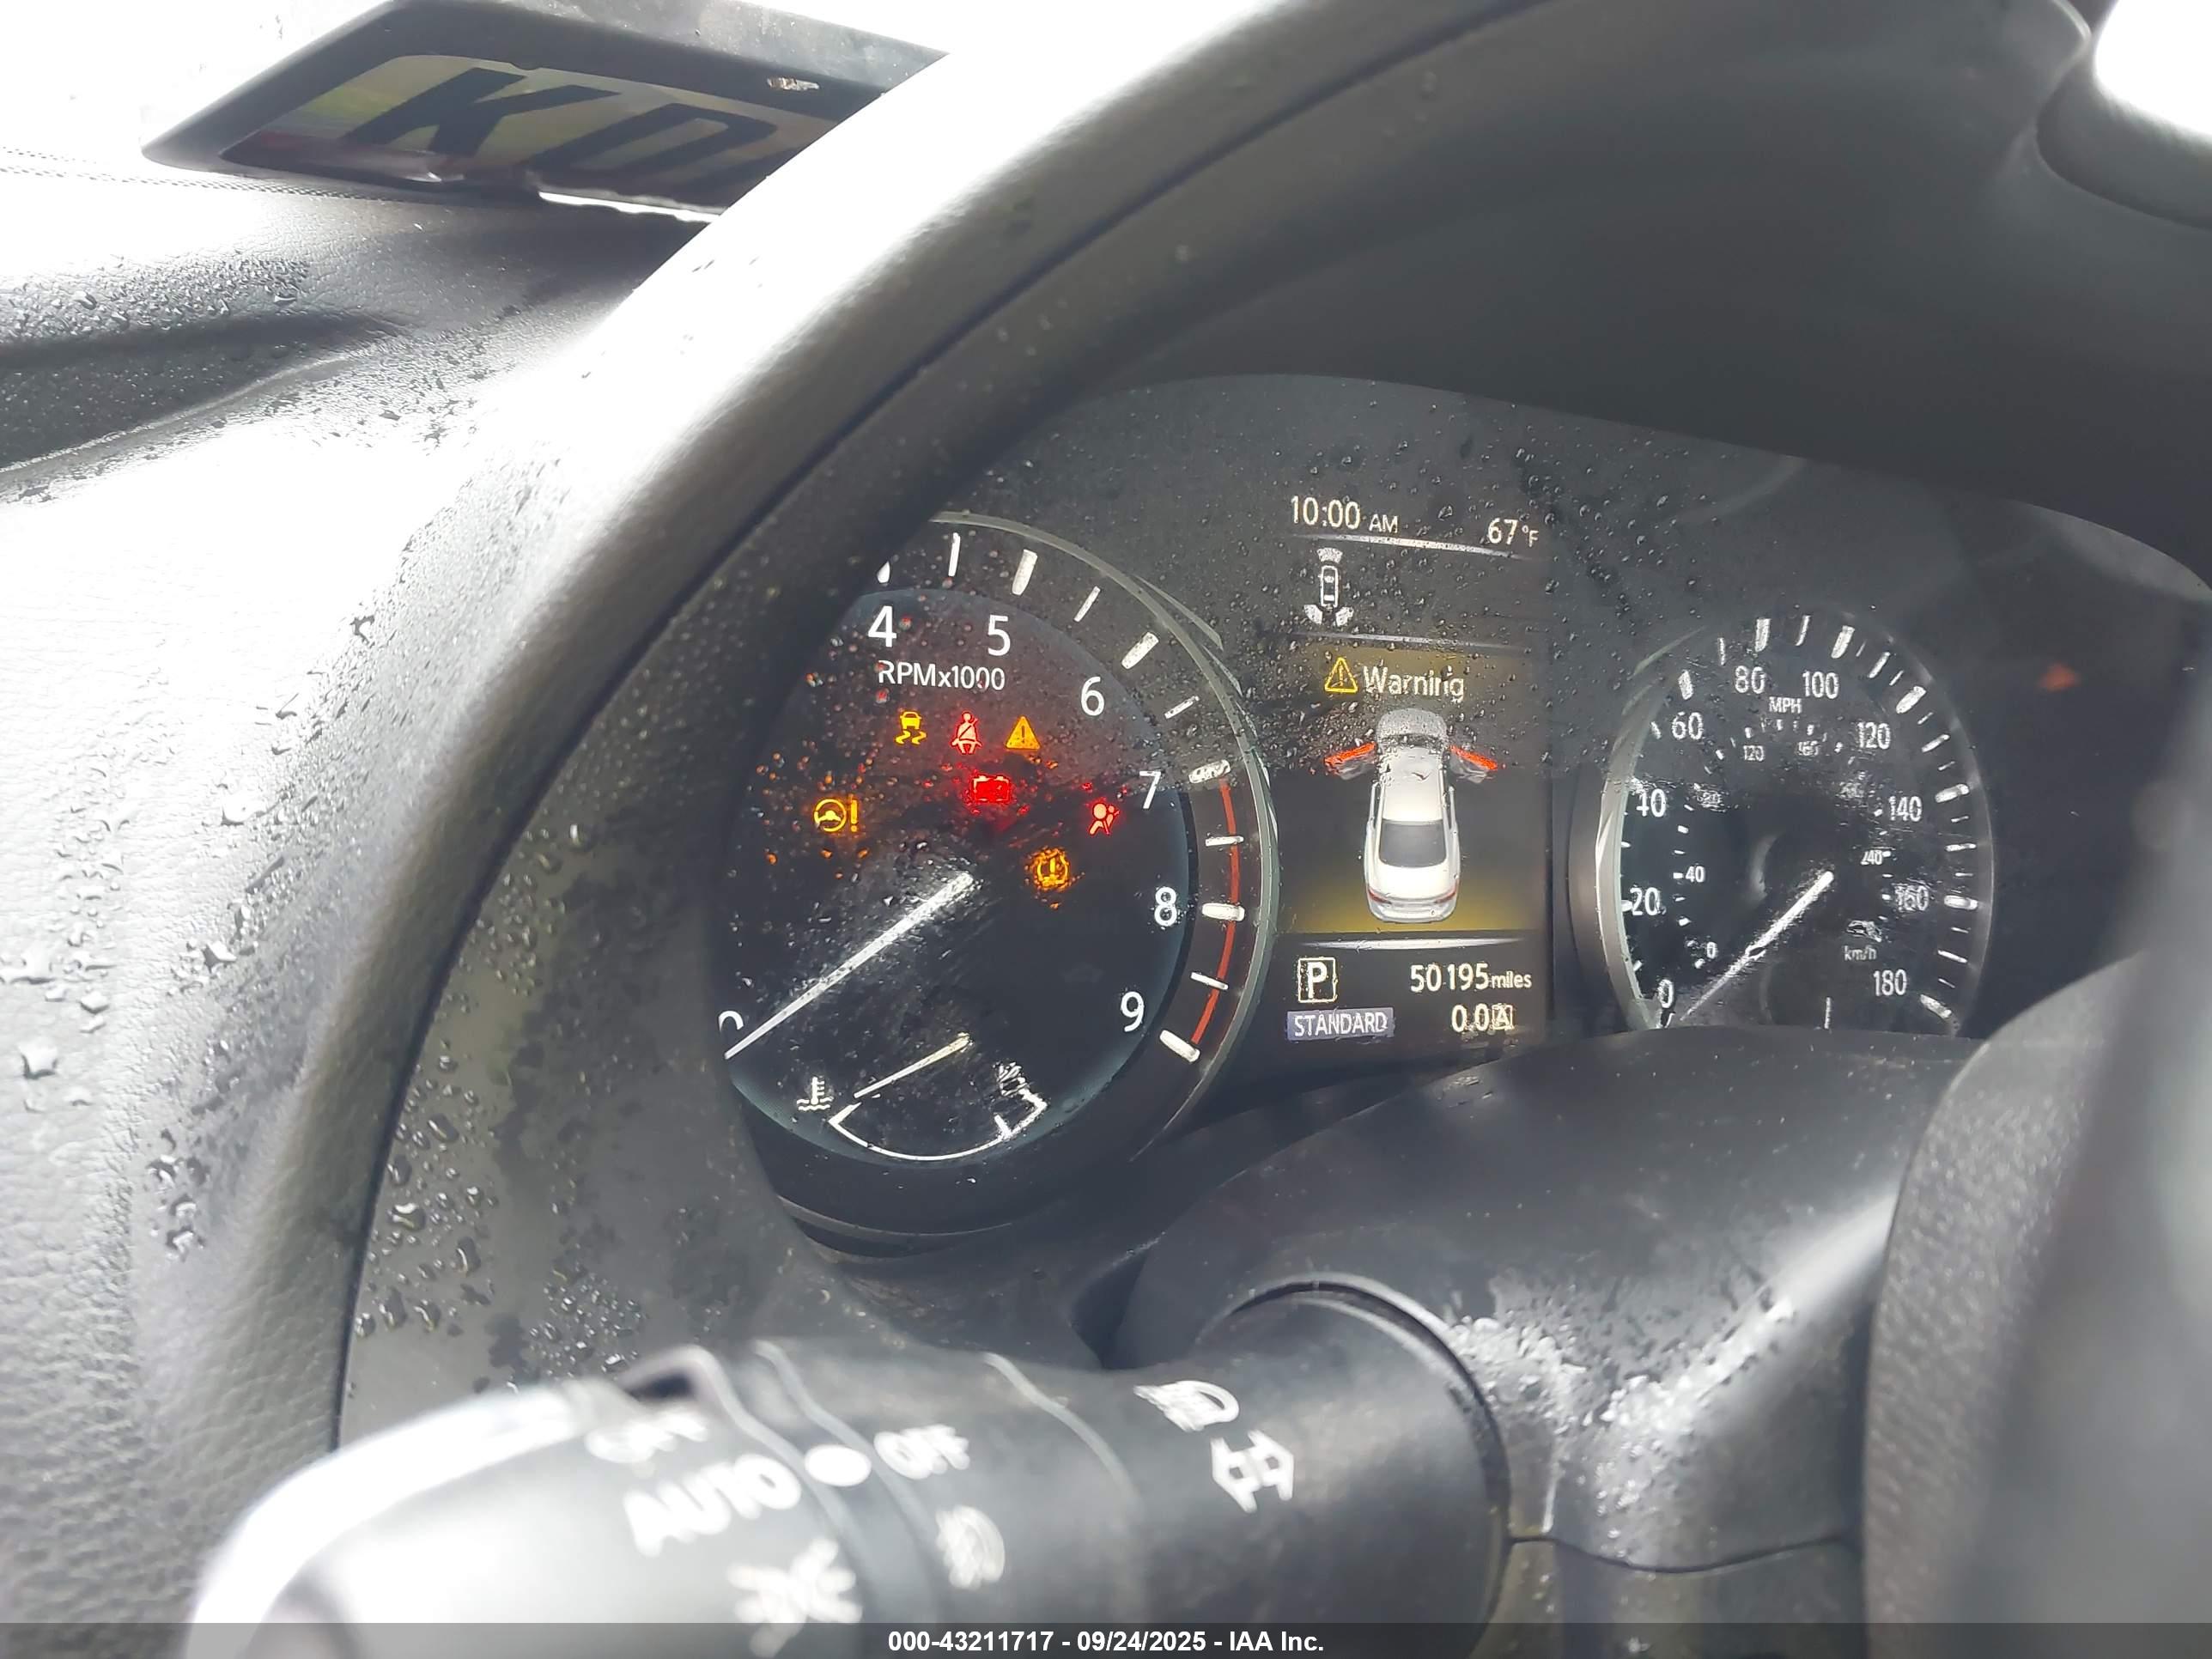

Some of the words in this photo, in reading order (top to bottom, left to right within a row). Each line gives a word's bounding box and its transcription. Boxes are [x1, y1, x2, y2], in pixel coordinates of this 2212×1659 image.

[1291, 495, 1361, 530] 10:00
[1369, 514, 1399, 533] AM
[868, 605, 896, 647] 4
[987, 615, 1011, 656] 5
[878, 660, 1006, 690] RPMx1000
[1364, 666, 1464, 702] Warning
[1735, 665, 1765, 694] 80
[1802, 672, 1839, 699] 100
[1081, 677, 1105, 715] 6
[1769, 696, 1802, 714] MPH
[1671, 712, 1704, 740] 60
[1857, 722, 1891, 750] 120
[1139, 771, 1162, 809] 7
[1889, 796, 1923, 822] 140
[1685, 866, 1705, 883] 40
[1155, 887, 1178, 926] 8
[1630, 886, 1661, 916] 20
[1844, 945, 1877, 960] km/h
[1307, 961, 1328, 998] P
[1410, 963, 1489, 993] 50195
[1492, 970, 1532, 988] miles
[1874, 969, 1906, 996] 180
[1658, 979, 1673, 1008] 0
[1121, 992, 1144, 1030] 9
[1294, 1012, 1388, 1037] STANDARD
[623, 1453, 801, 1558] AUTO
